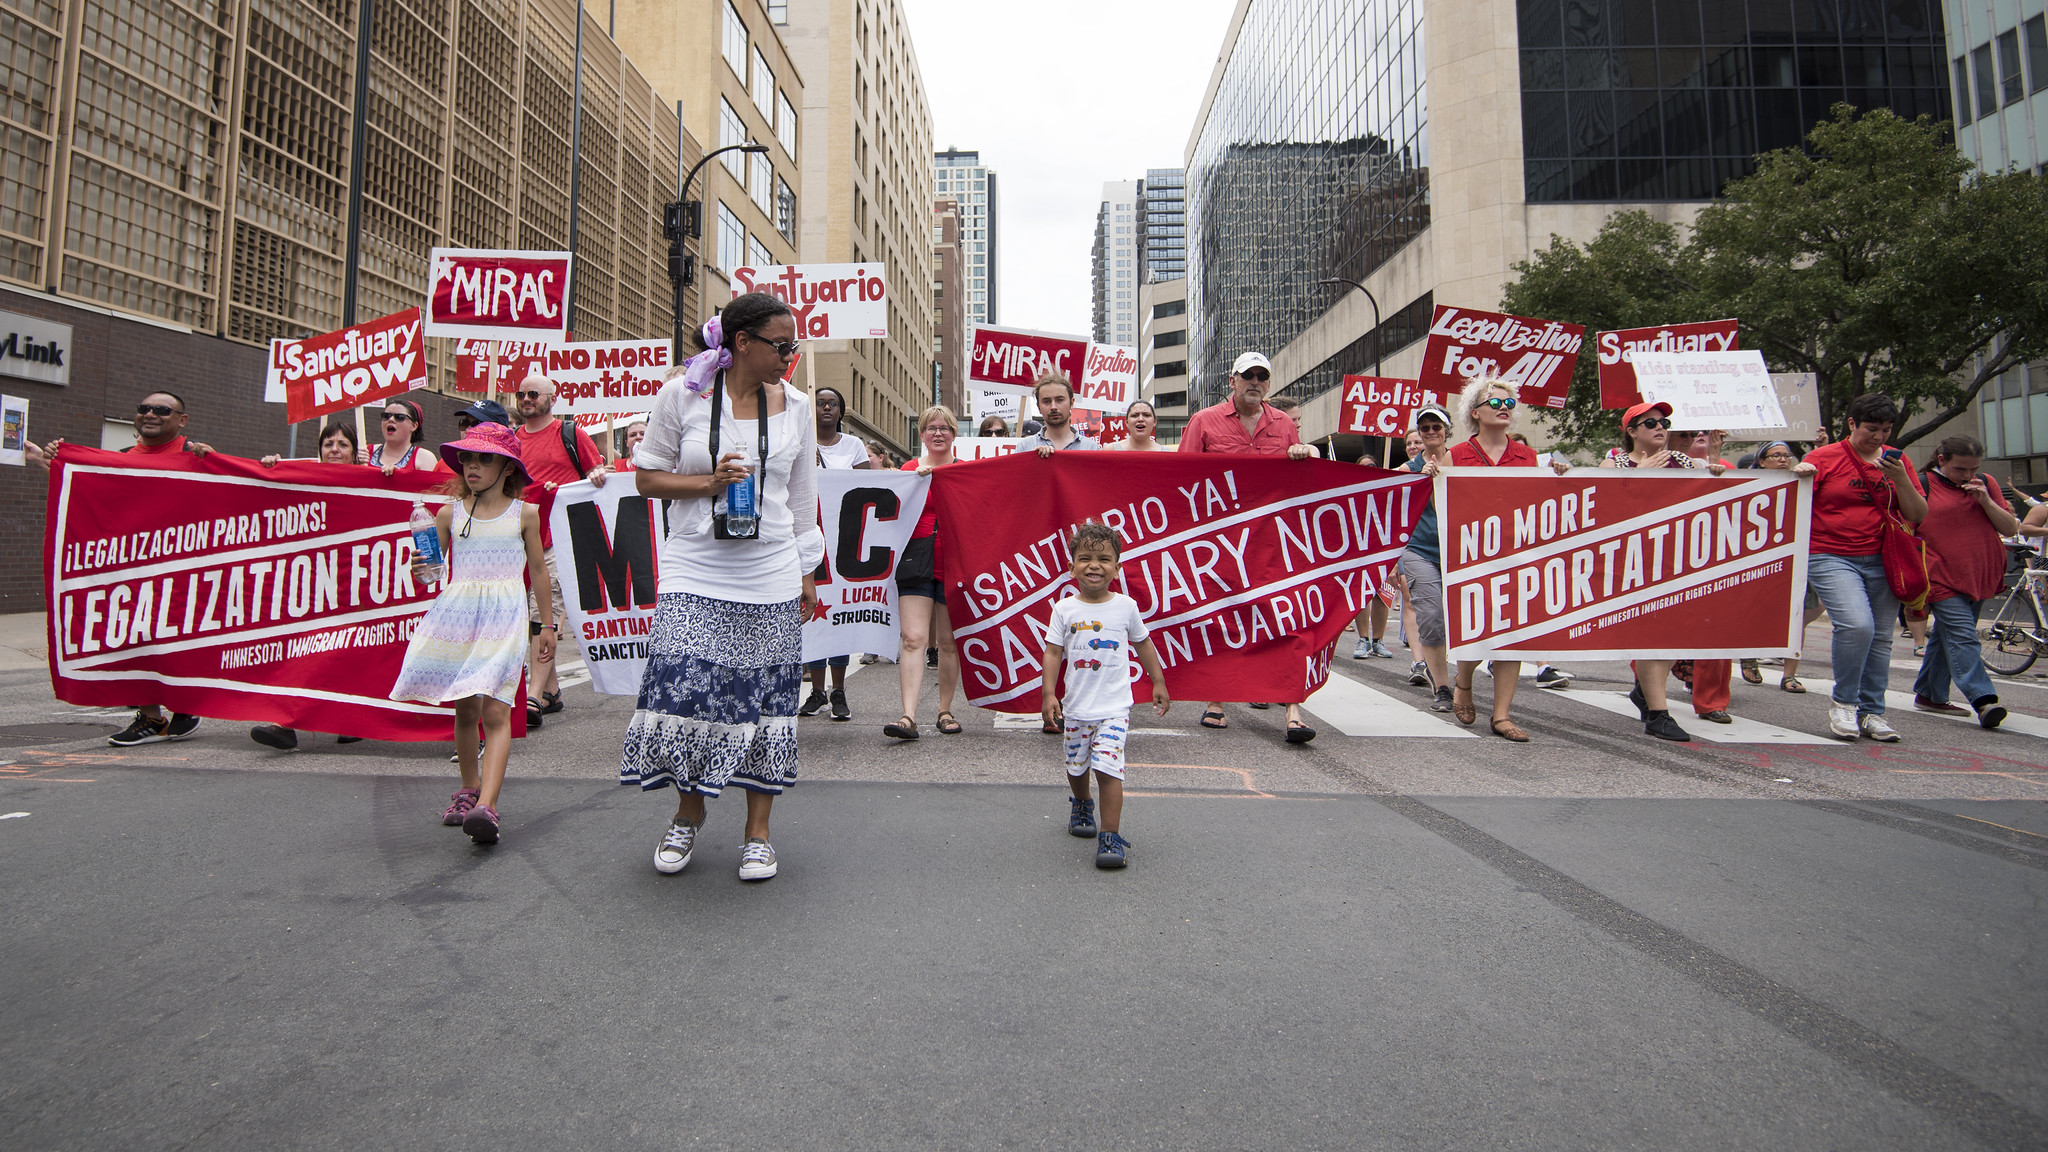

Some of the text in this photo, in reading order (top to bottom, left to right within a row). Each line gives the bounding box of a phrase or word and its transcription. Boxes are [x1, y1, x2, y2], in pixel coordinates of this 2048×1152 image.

[450, 266, 558, 322] MIRAC
[790, 305, 829, 339] Ya
[1430, 309, 1582, 354] Legalization
[285, 320, 420, 380] Sanctuary
[474, 361, 513, 378] Fr
[549, 349, 591, 371] NO
[595, 346, 668, 369] MORE
[983, 340, 1071, 381] MIRAC
[1087, 346, 1137, 377] lization
[1442, 345, 1563, 388] For All
[1637, 360, 1673, 376] kids
[1676, 361, 1741, 377] standing
[313, 351, 417, 407] NOW
[1345, 381, 1438, 407] Abolish
[1693, 380, 1718, 394] for
[1682, 401, 1751, 417] families
[65, 501, 327, 572] ¡LEGALIZACION PARA TODXS!
[957, 496, 1168, 619] ¡SANTURIO
[1178, 470, 1241, 522] YA!
[1275, 485, 1412, 573] NOW!
[1459, 486, 1597, 564] NO MORE
[1460, 487, 1787, 641] DEPORTATIONS!
[64, 549, 340, 655] LEGALIZATION
[350, 536, 416, 606] FOR
[841, 586, 888, 605] LUCHA
[1569, 622, 1592, 639] MIRAC
[1598, 606, 1640, 629] MINNESOTA
[1641, 592, 1684, 615] IMMIGRANT
[1685, 583, 1712, 601] RIGHTS
[1713, 574, 1740, 592] ACTION
[1741, 560, 1783, 582] COMMITTEE
[582, 616, 652, 641] SANTUA
[832, 610, 891, 627] STRUGGLE
[221, 641, 283, 670] MINNESOTA
[287, 627, 357, 660] IMMIGRANT
[354, 622, 395, 647] RIGHTS
[588, 641, 650, 662] SANCTU
